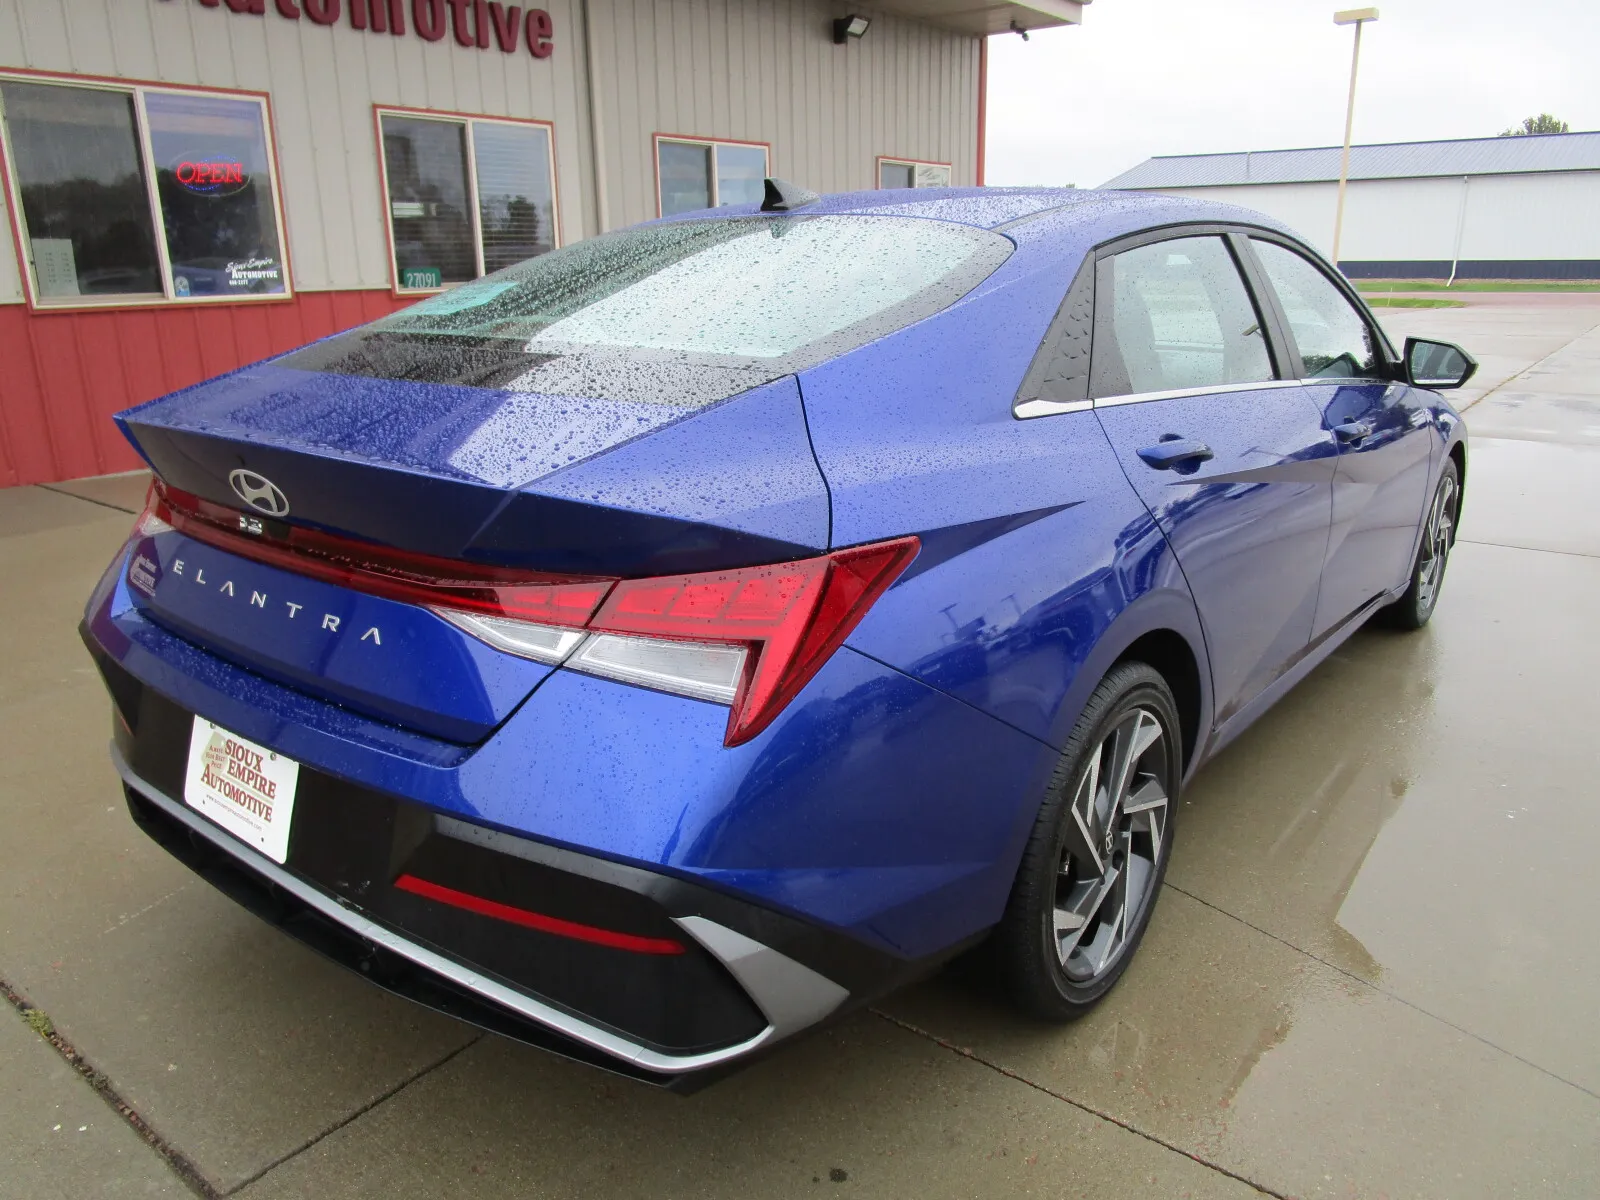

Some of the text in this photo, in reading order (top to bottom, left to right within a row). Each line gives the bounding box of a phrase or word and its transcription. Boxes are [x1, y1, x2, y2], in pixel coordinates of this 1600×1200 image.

[158, 0, 554, 59] omotive
[176, 161, 243, 184] OPEN
[231, 270, 278, 279] AUTOMOTIVE
[406, 272, 436, 288] 27091
[172, 559, 381, 645] ELANTRA
[225, 739, 263, 773] SIOUX
[200, 763, 272, 823] AUTOMOTIVE
[227, 758, 277, 799] EMPIRE
